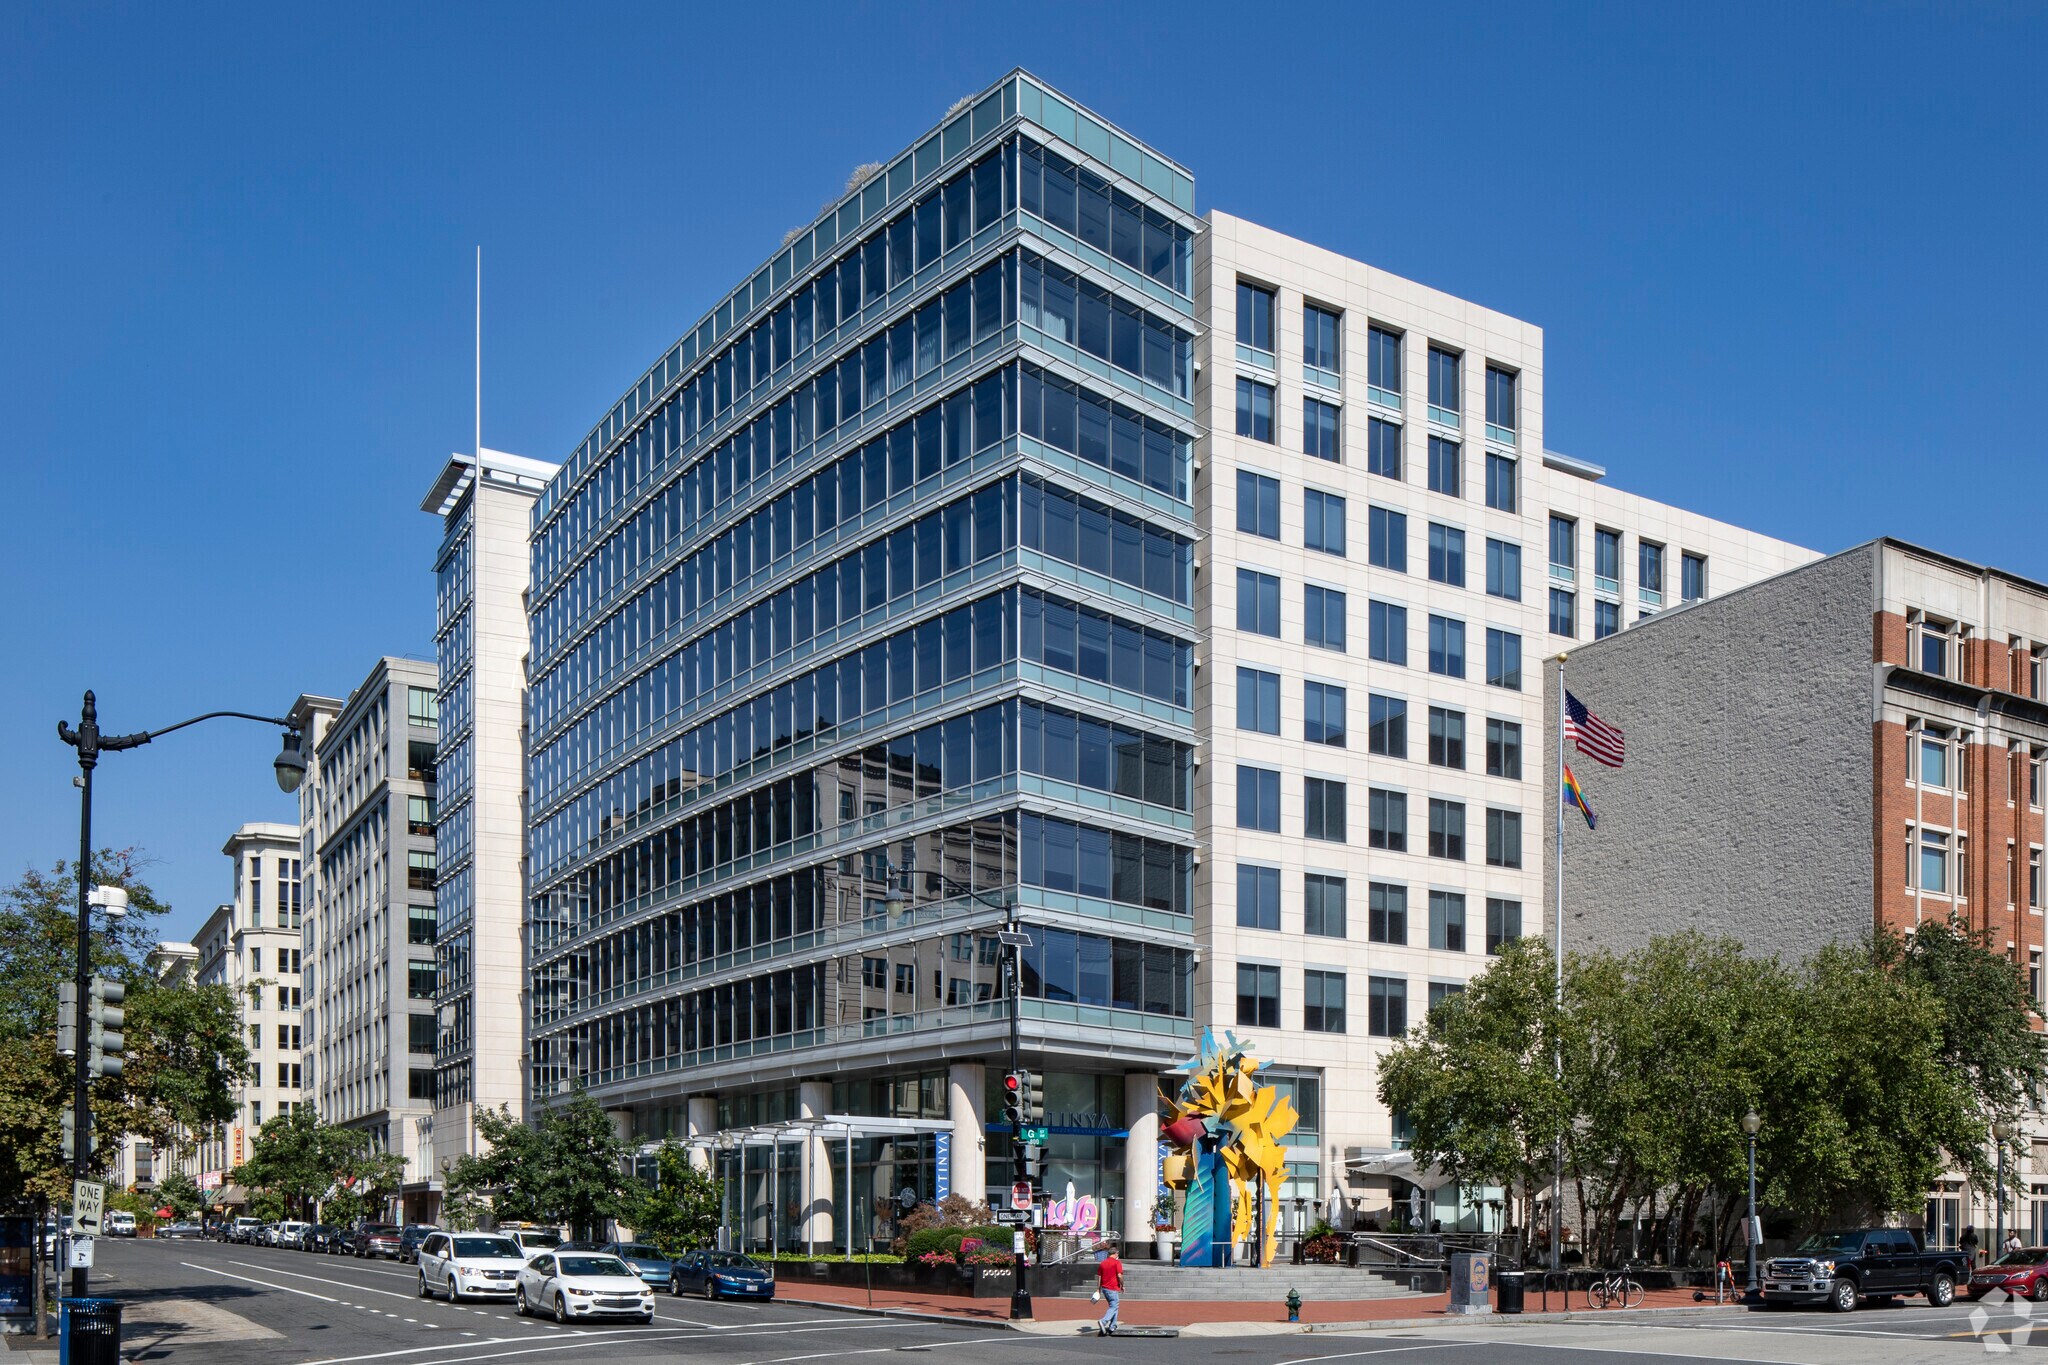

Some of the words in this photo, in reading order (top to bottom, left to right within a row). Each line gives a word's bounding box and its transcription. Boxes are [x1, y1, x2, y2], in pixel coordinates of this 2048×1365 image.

[1033, 1111, 1111, 1128] TINYA
[1027, 1129, 1035, 1138] G
[937, 1135, 948, 1212] AYTINYA
[80, 1185, 100, 1200] ONE
[79, 1200, 99, 1213] WAY
[982, 1269, 1011, 1279] popco
